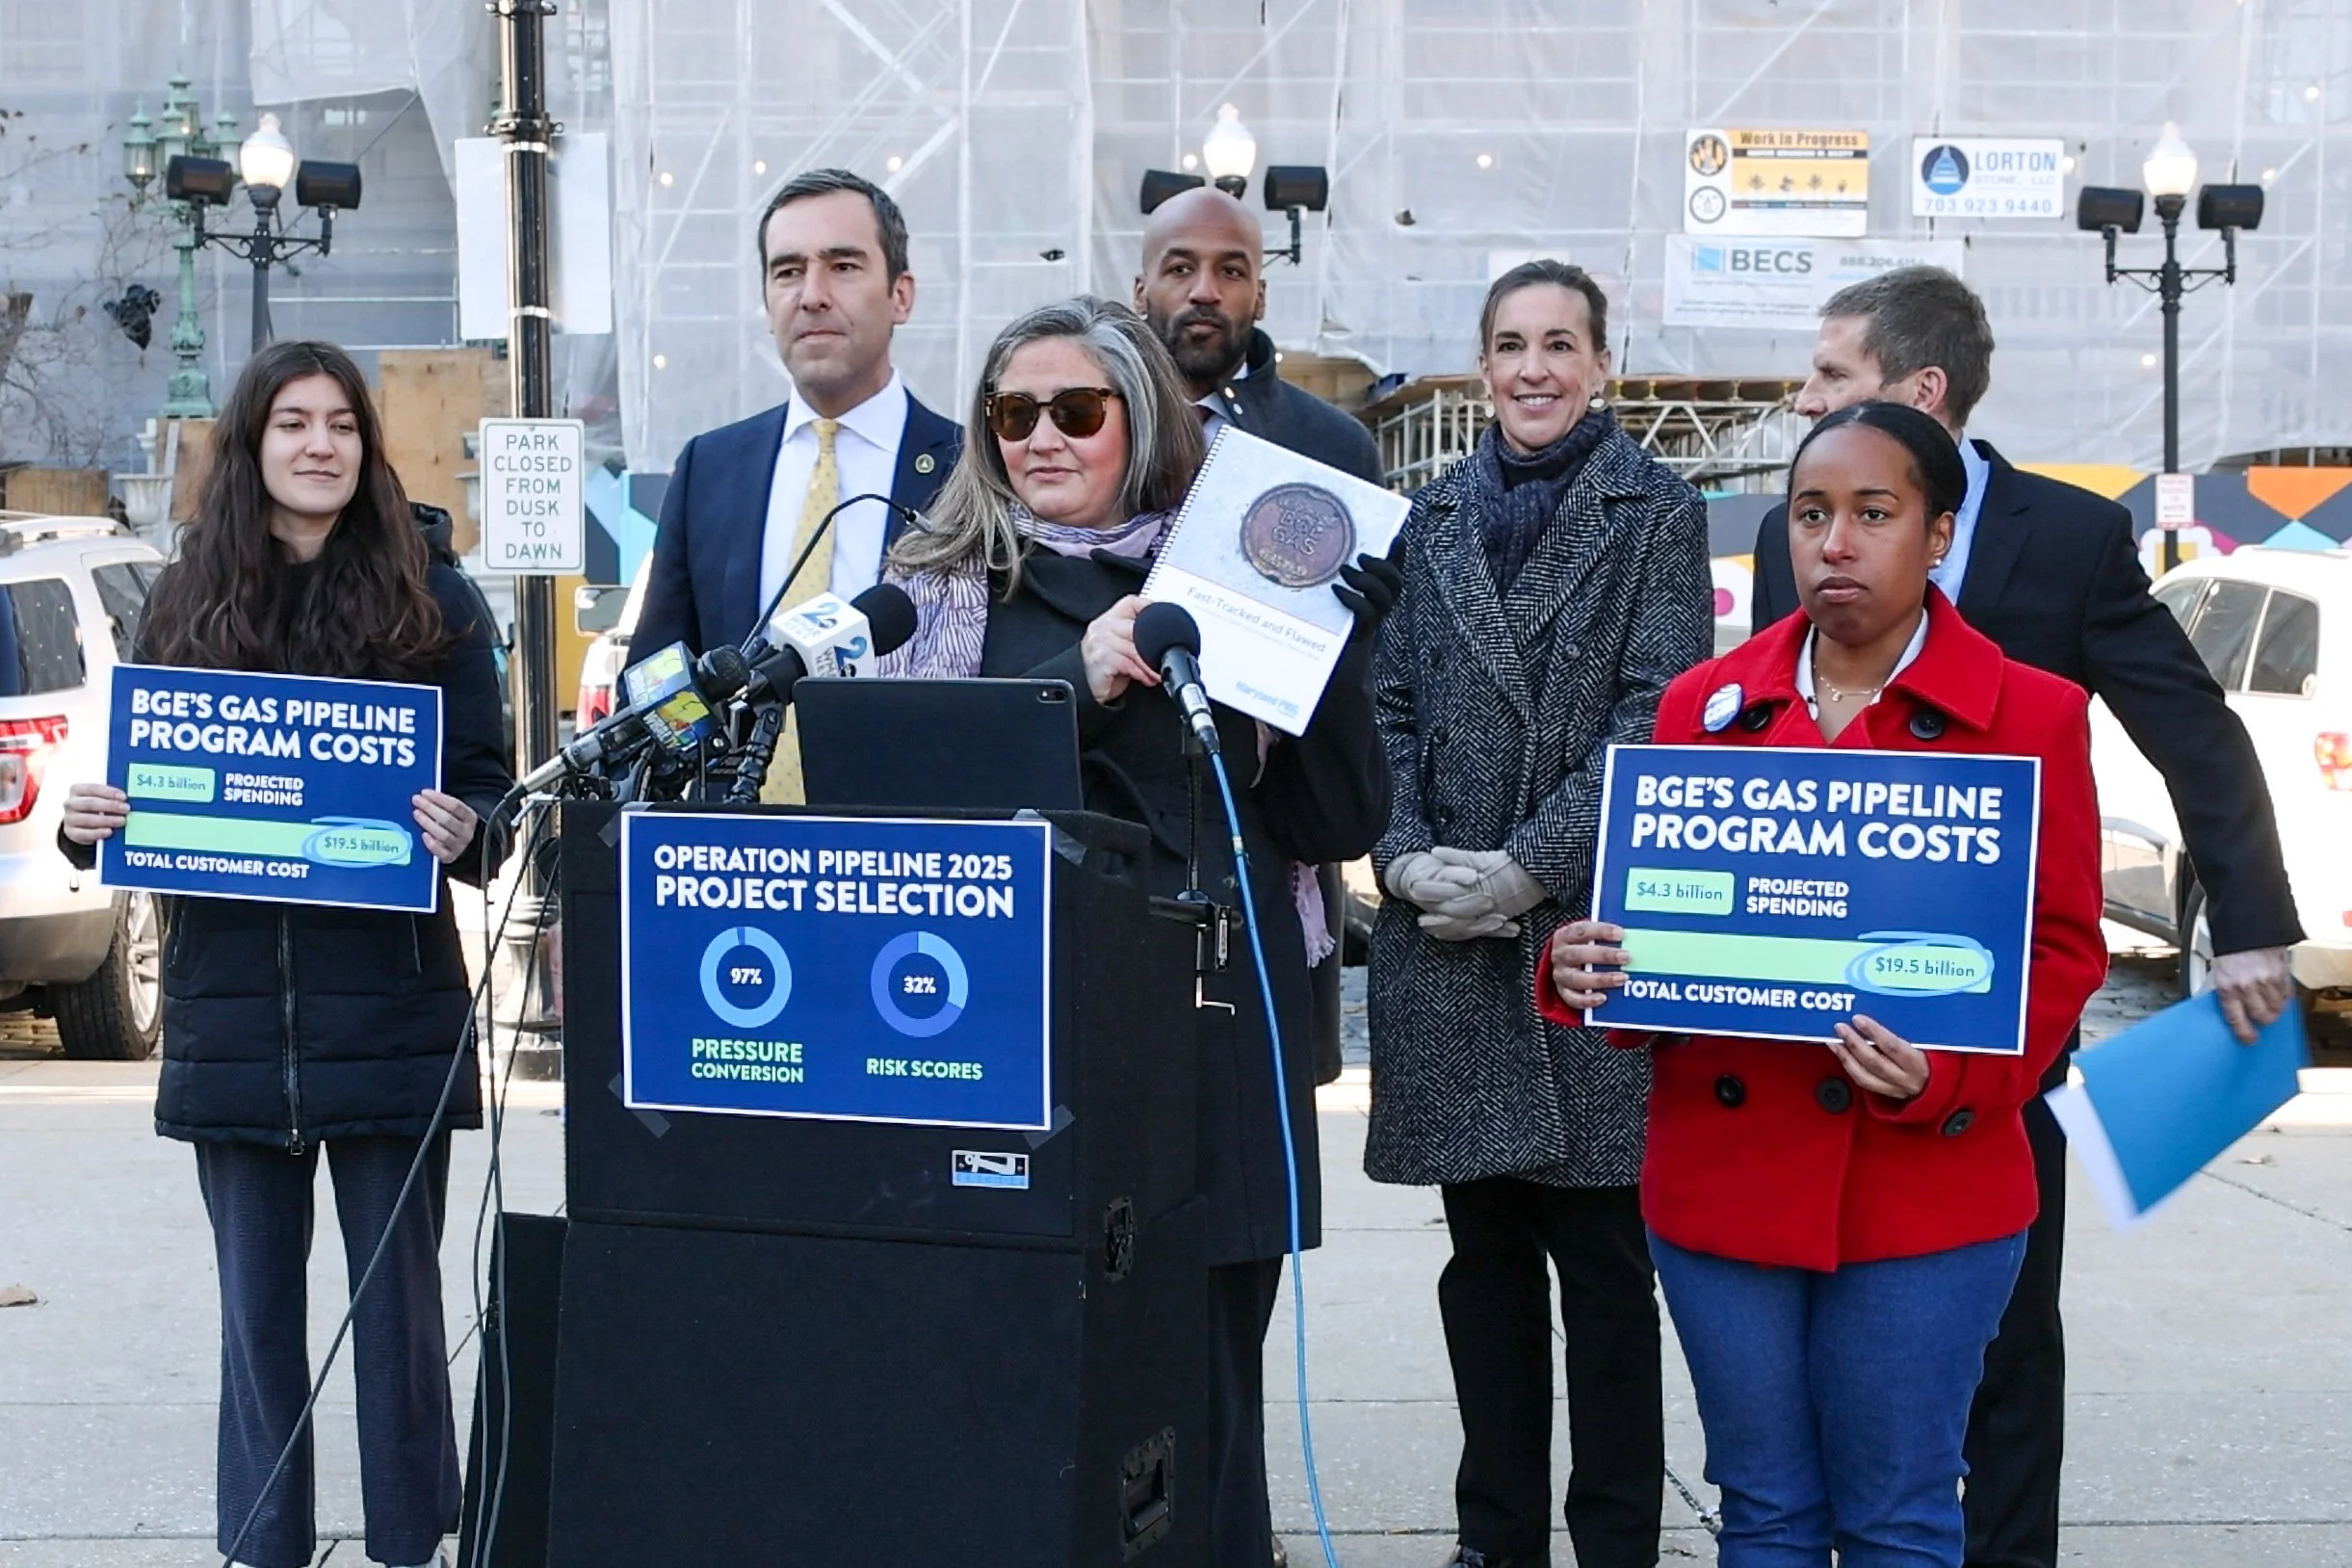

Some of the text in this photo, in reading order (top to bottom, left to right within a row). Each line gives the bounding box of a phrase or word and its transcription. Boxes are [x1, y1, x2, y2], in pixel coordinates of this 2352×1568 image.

[1740, 132, 1859, 147] Work In Progress
[1974, 151, 2056, 171] LORTON
[1731, 248, 1814, 274] BECS
[506, 434, 559, 451] PARK
[494, 456, 572, 472] CLOSED
[506, 478, 561, 494] FROM
[506, 500, 560, 516] DUSK
[521, 521, 545, 537] TO
[505, 542, 562, 560] DAWN
[1188, 588, 1261, 624] Fast-Tracked
[1262, 618, 1283, 634] and
[1286, 628, 1326, 652] Flawed
[219, 695, 278, 723] GAS
[285, 699, 416, 734] PIPELINE
[130, 719, 416, 768] PROGRAM COSTS
[137, 773, 206, 791] $4.3 billion
[225, 772, 303, 792] PROJECTED
[223, 787, 303, 806] SPENDING
[1742, 779, 1817, 813] GAS
[1826, 781, 2002, 821] PIPELINE
[324, 835, 399, 853] $19.5 billion
[1631, 813, 2001, 864] PROGRAM COSTS
[125, 850, 310, 879] TOTAL CUSTOMER COST
[654, 844, 1012, 880] OPERATION PIPELINE 2025
[656, 875, 1014, 919] PROJECT SELECTION
[1636, 880, 1723, 902] $4.3 billion
[1748, 876, 1849, 898] PROJECTED
[1746, 896, 1847, 919] SPENDING
[730, 967, 762, 985] 97%
[1875, 955, 1974, 979] $19.5 billion
[903, 976, 936, 994] 32%
[1624, 980, 1856, 1012] TOTAL CUSTOMER COST
[692, 1037, 803, 1064] PRESSURE
[691, 1061, 804, 1084] CONVERSION
[866, 1057, 983, 1081] RISK SCORES
